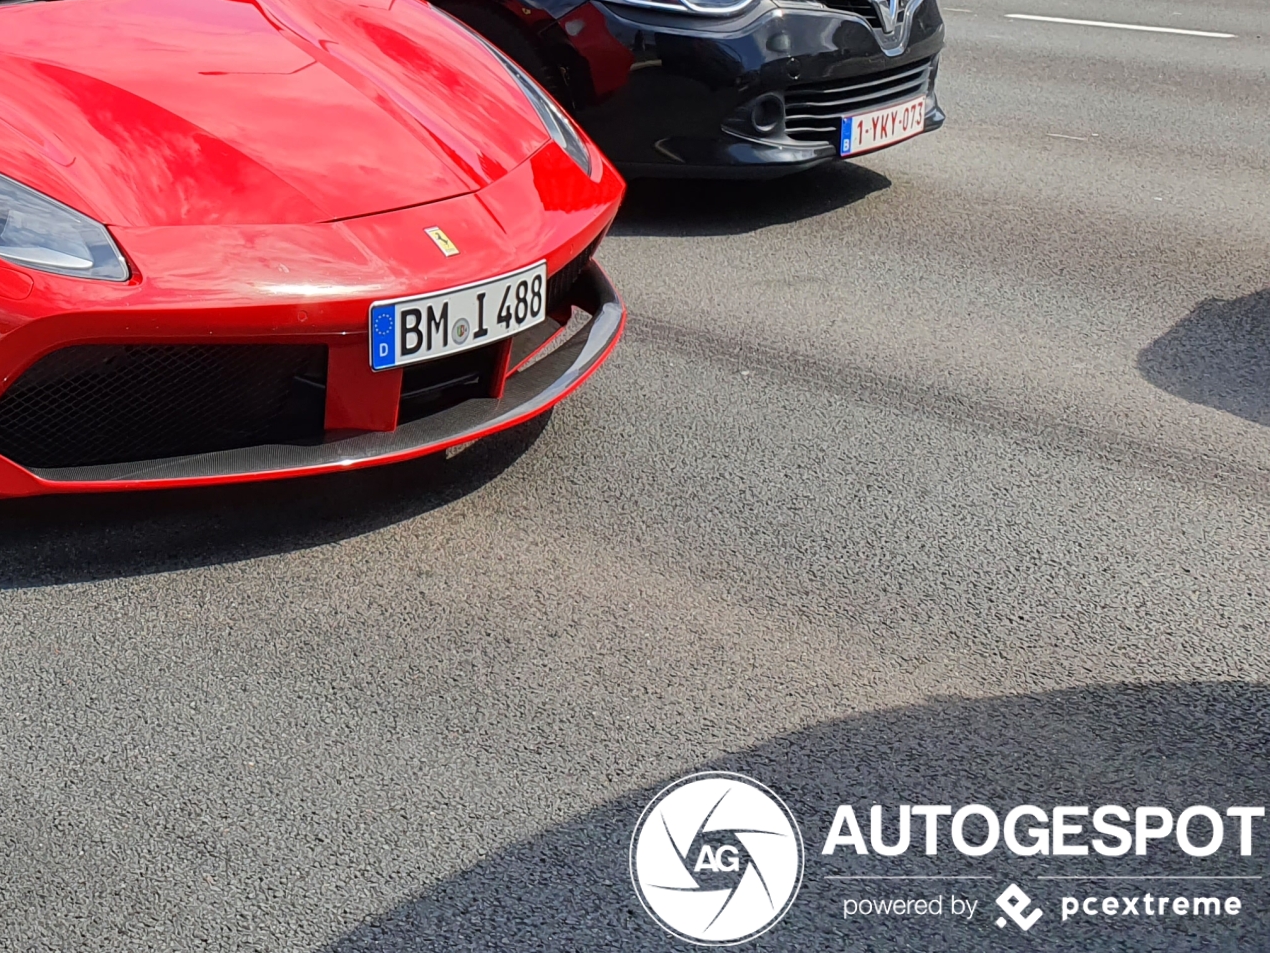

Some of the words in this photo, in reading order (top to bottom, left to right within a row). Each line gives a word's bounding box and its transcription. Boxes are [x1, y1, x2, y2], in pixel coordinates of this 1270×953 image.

[856, 100, 924, 146] 1-YKY-073
[379, 342, 389, 358] D
[399, 300, 450, 358] BM
[473, 291, 489, 340] I
[496, 273, 543, 330] 488
